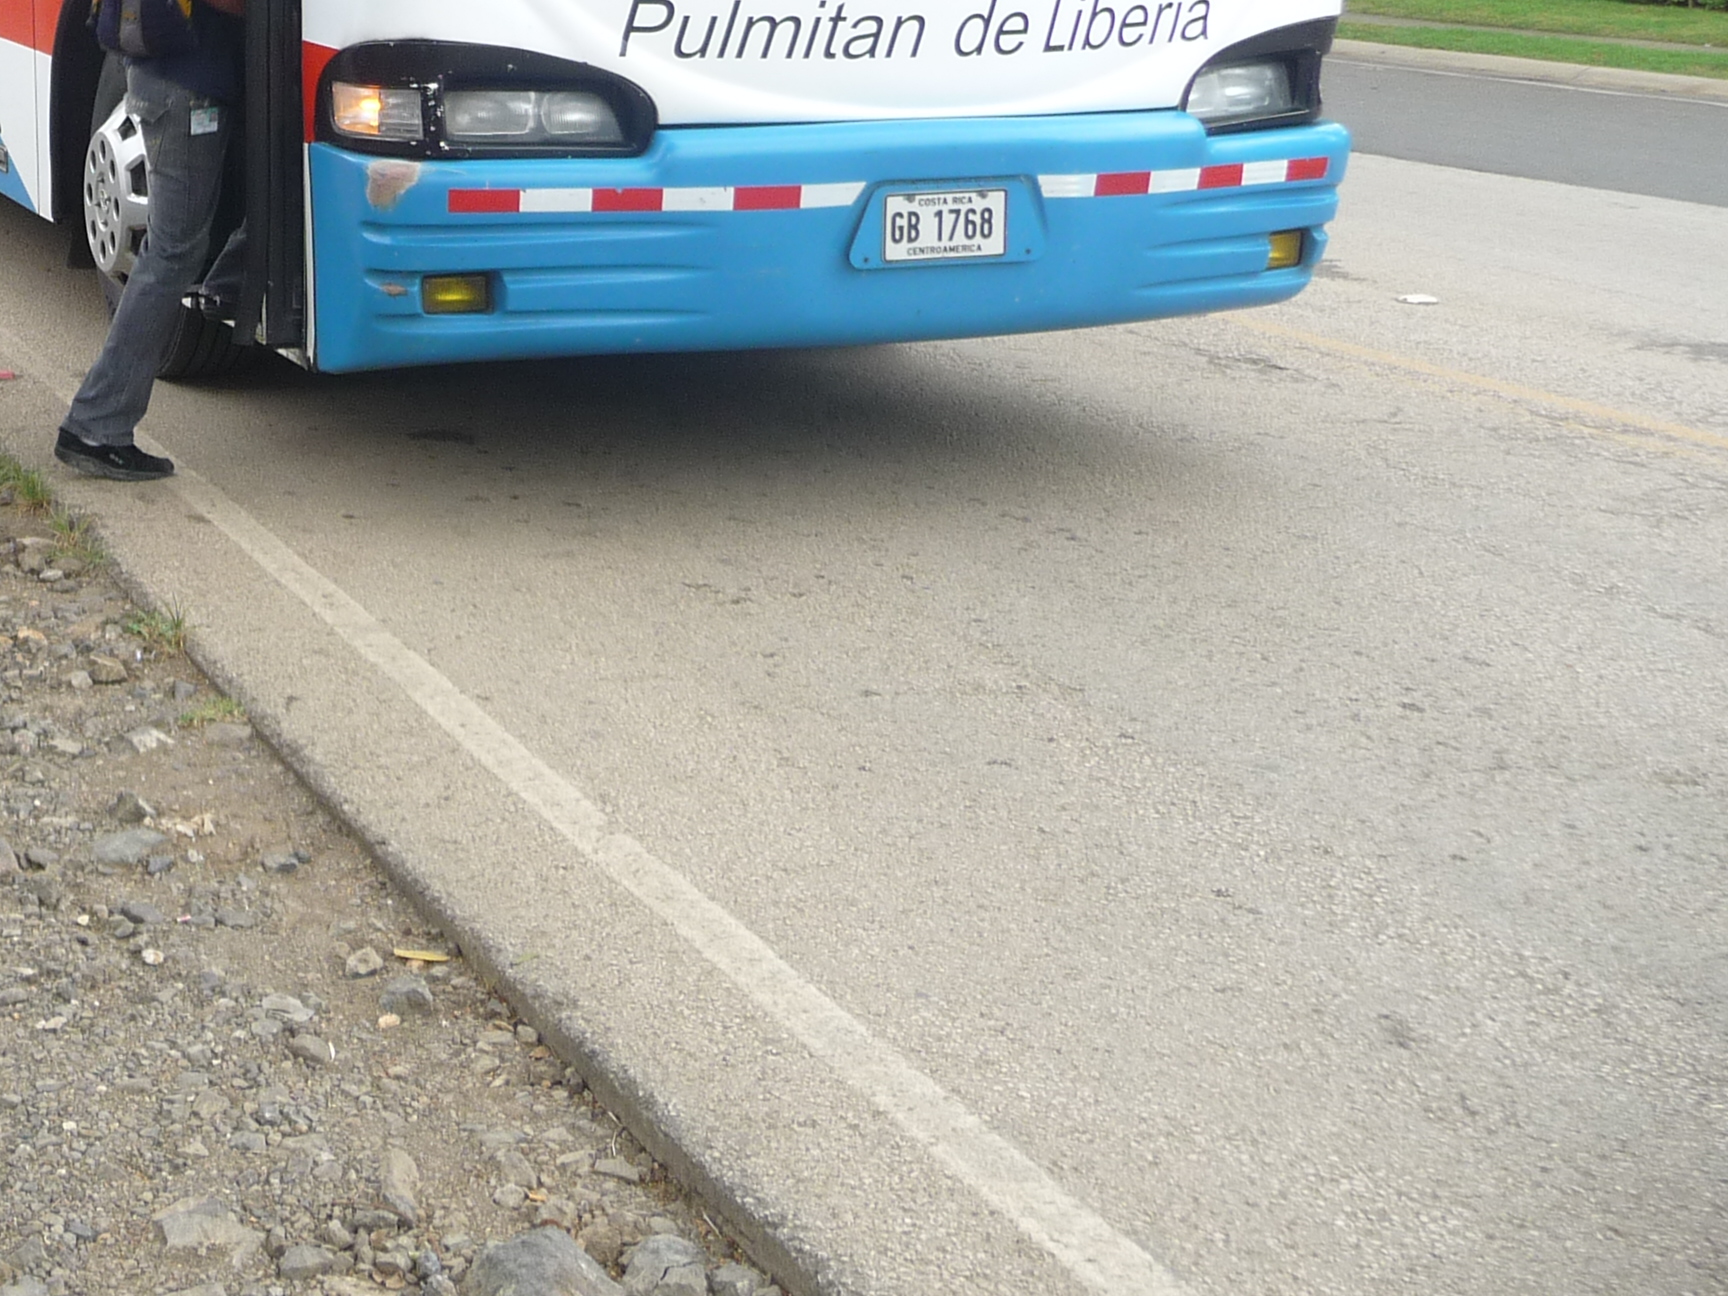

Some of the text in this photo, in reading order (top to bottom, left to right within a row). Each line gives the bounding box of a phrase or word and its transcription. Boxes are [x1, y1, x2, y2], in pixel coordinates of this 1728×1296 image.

[918, 195, 973, 207] COSTA RICA
[891, 207, 993, 244] GB 1768
[907, 244, 982, 256] CENTROAMERICA
